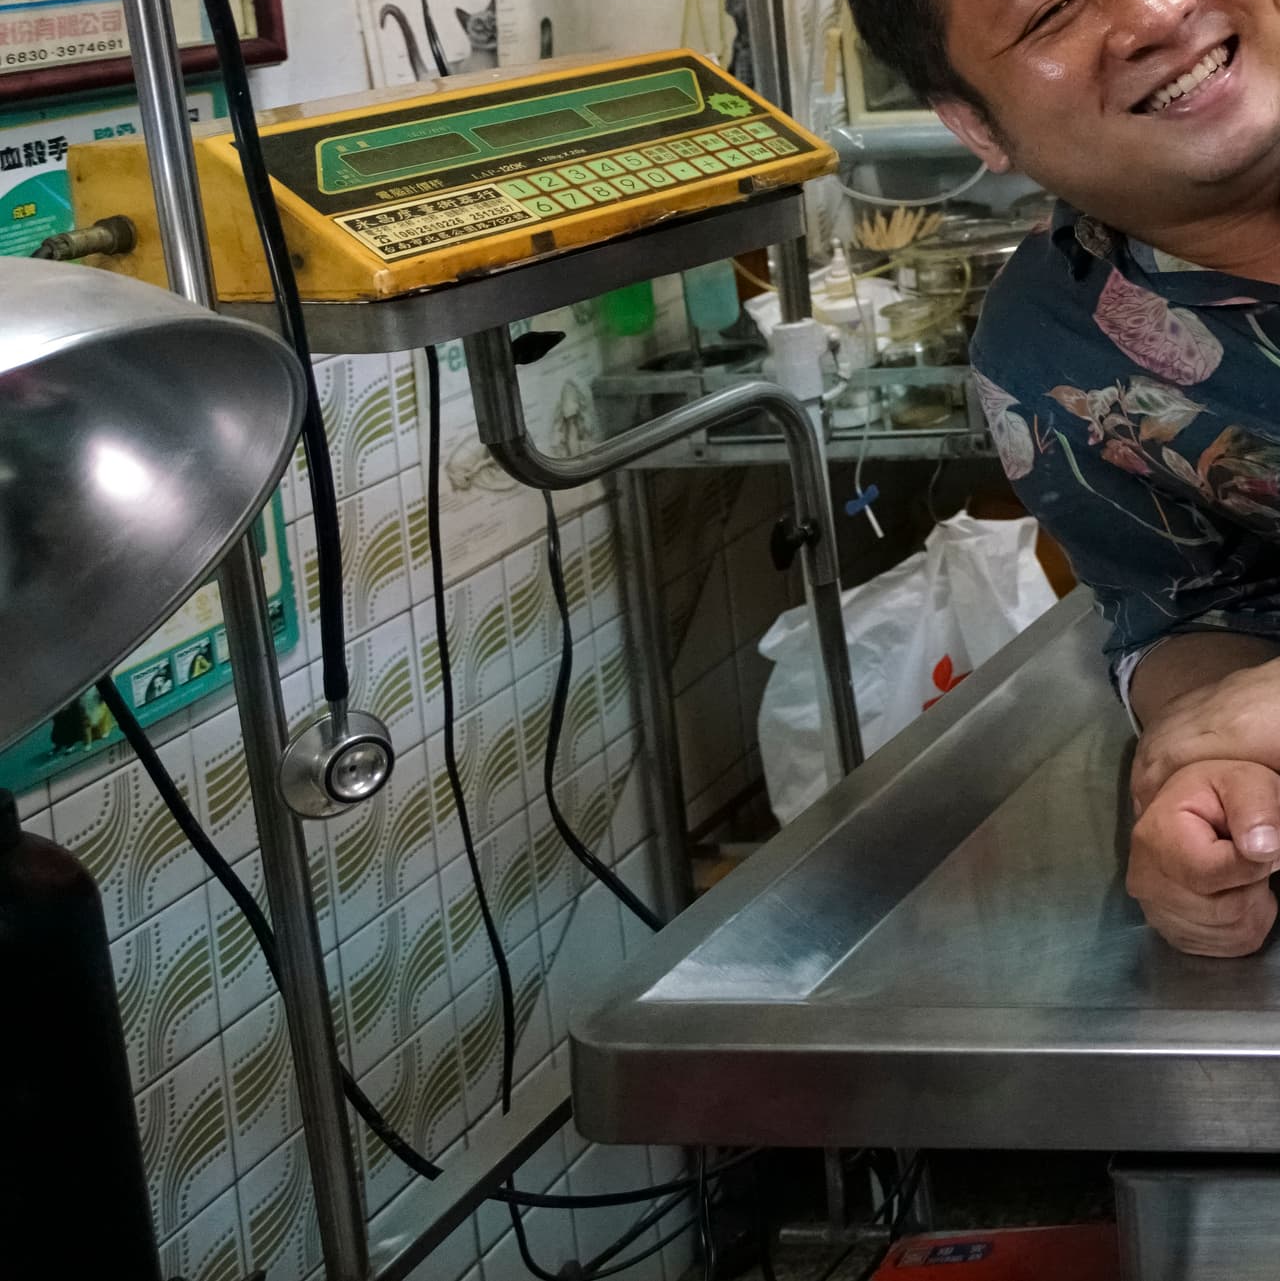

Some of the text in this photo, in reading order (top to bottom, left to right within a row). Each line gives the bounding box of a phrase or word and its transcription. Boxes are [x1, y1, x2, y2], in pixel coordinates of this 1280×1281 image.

[539, 175, 561, 188] 2
[568, 169, 588, 181] 3
[599, 162, 616, 174] 4
[626, 155, 642, 168] 5
[536, 171, 666, 213] 6 7 8 9 0
